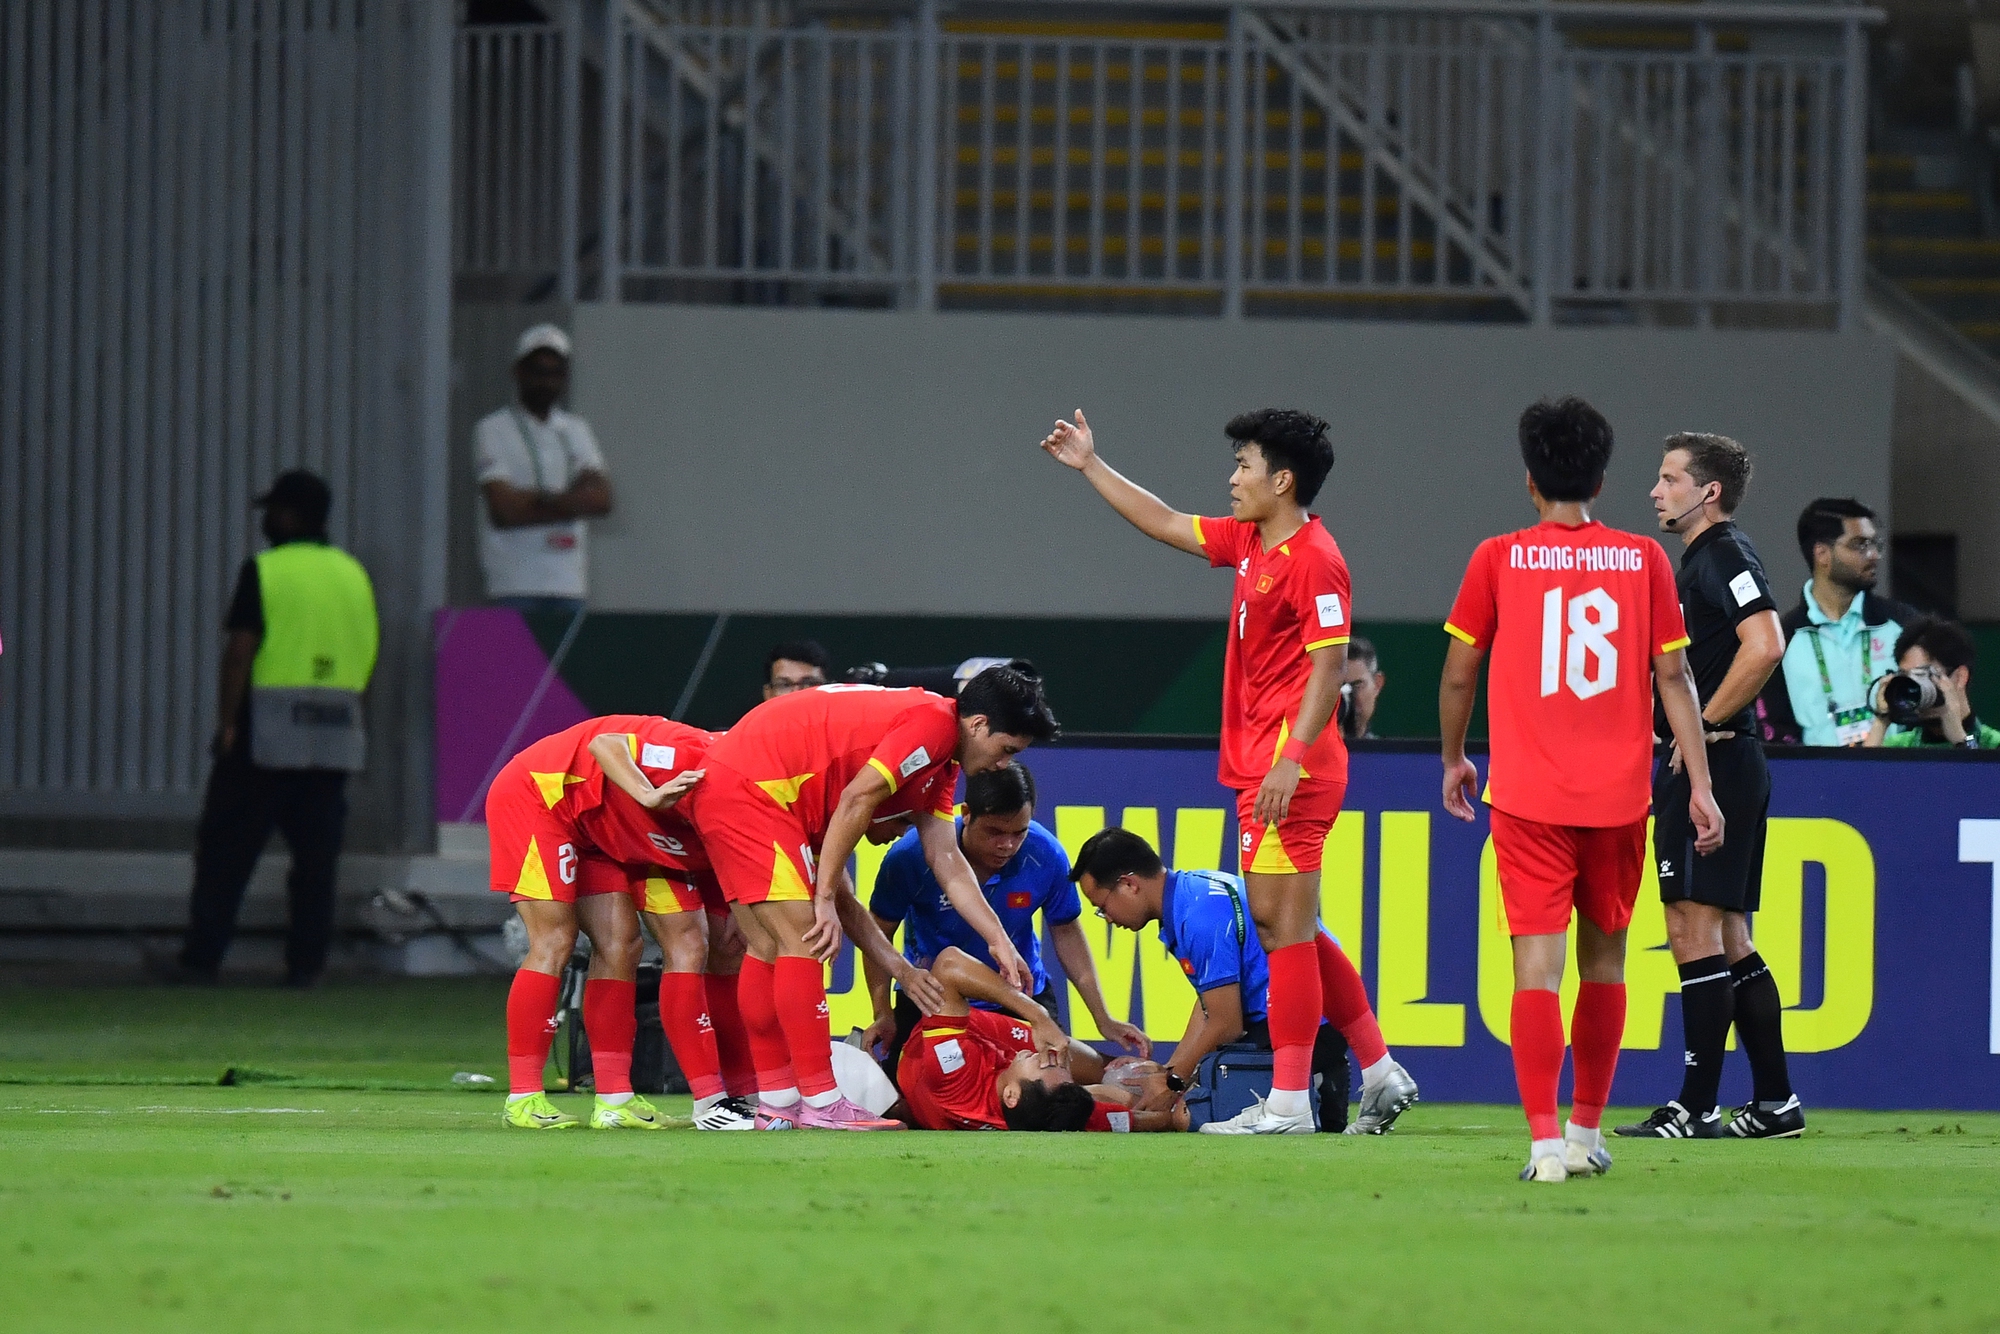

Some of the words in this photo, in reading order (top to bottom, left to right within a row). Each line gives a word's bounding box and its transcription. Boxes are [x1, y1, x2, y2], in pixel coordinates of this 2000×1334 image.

[1510, 544, 1574, 570] N.CONG
[1576, 546, 1643, 572] PHUONG
[1540, 586, 1619, 701] 18
